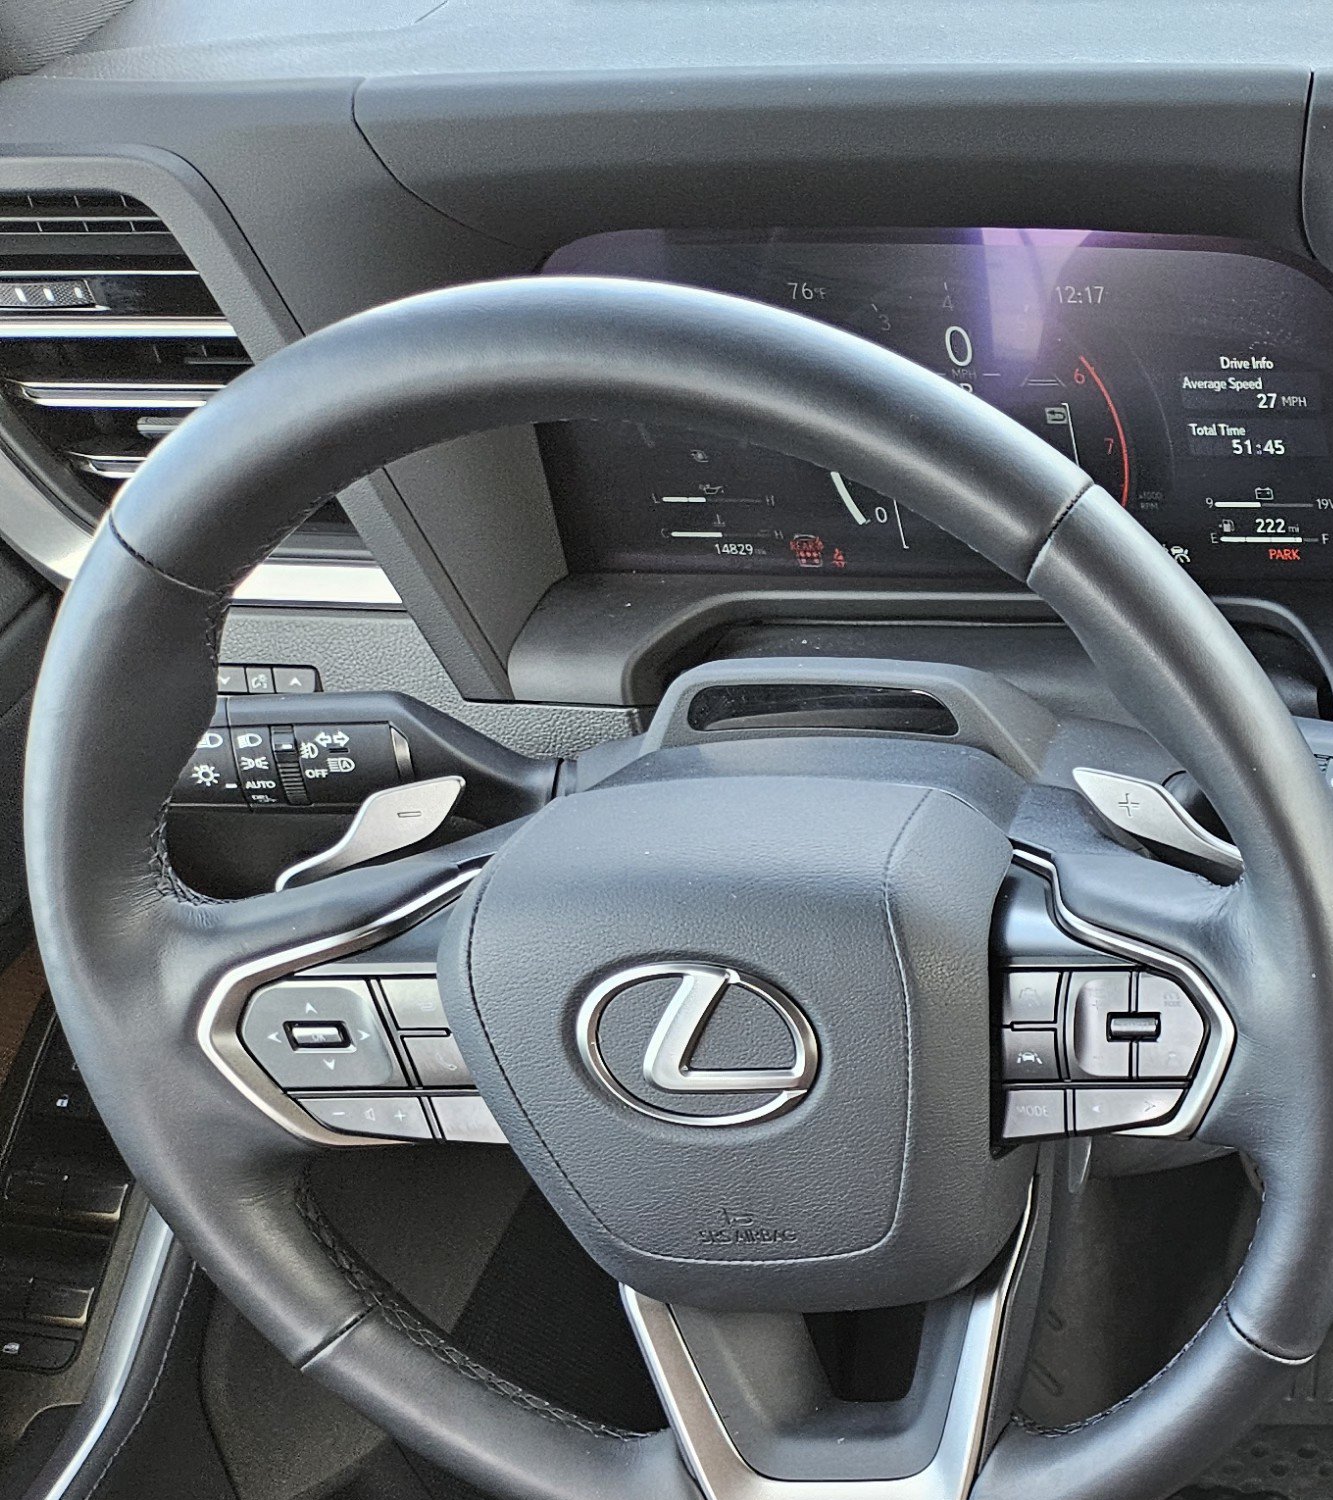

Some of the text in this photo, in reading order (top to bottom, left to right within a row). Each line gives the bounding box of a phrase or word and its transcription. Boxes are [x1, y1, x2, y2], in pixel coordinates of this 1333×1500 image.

[1055, 286, 1104, 304] 12:17
[878, 315, 891, 330] 3
[945, 326, 972, 366] 0
[1220, 356, 1274, 369] Drive Info
[951, 367, 977, 380] MPH
[1074, 367, 1086, 385] 6
[1183, 377, 1263, 391] Average Speed
[1257, 393, 1307, 409] 27 MPH
[1189, 423, 1246, 436] Total Time
[1104, 438, 1113, 455] 7
[1232, 440, 1285, 454] 51:45
[1206, 498, 1214, 508] 9
[875, 507, 887, 523] 0
[1255, 519, 1300, 533] 222 mi
[1211, 533, 1219, 544] E
[1322, 533, 1329, 544] F
[714, 543, 753, 556] 14829
[1269, 549, 1300, 560] PARK
[305, 769, 329, 779] OFF
[245, 780, 276, 790] AUTO
